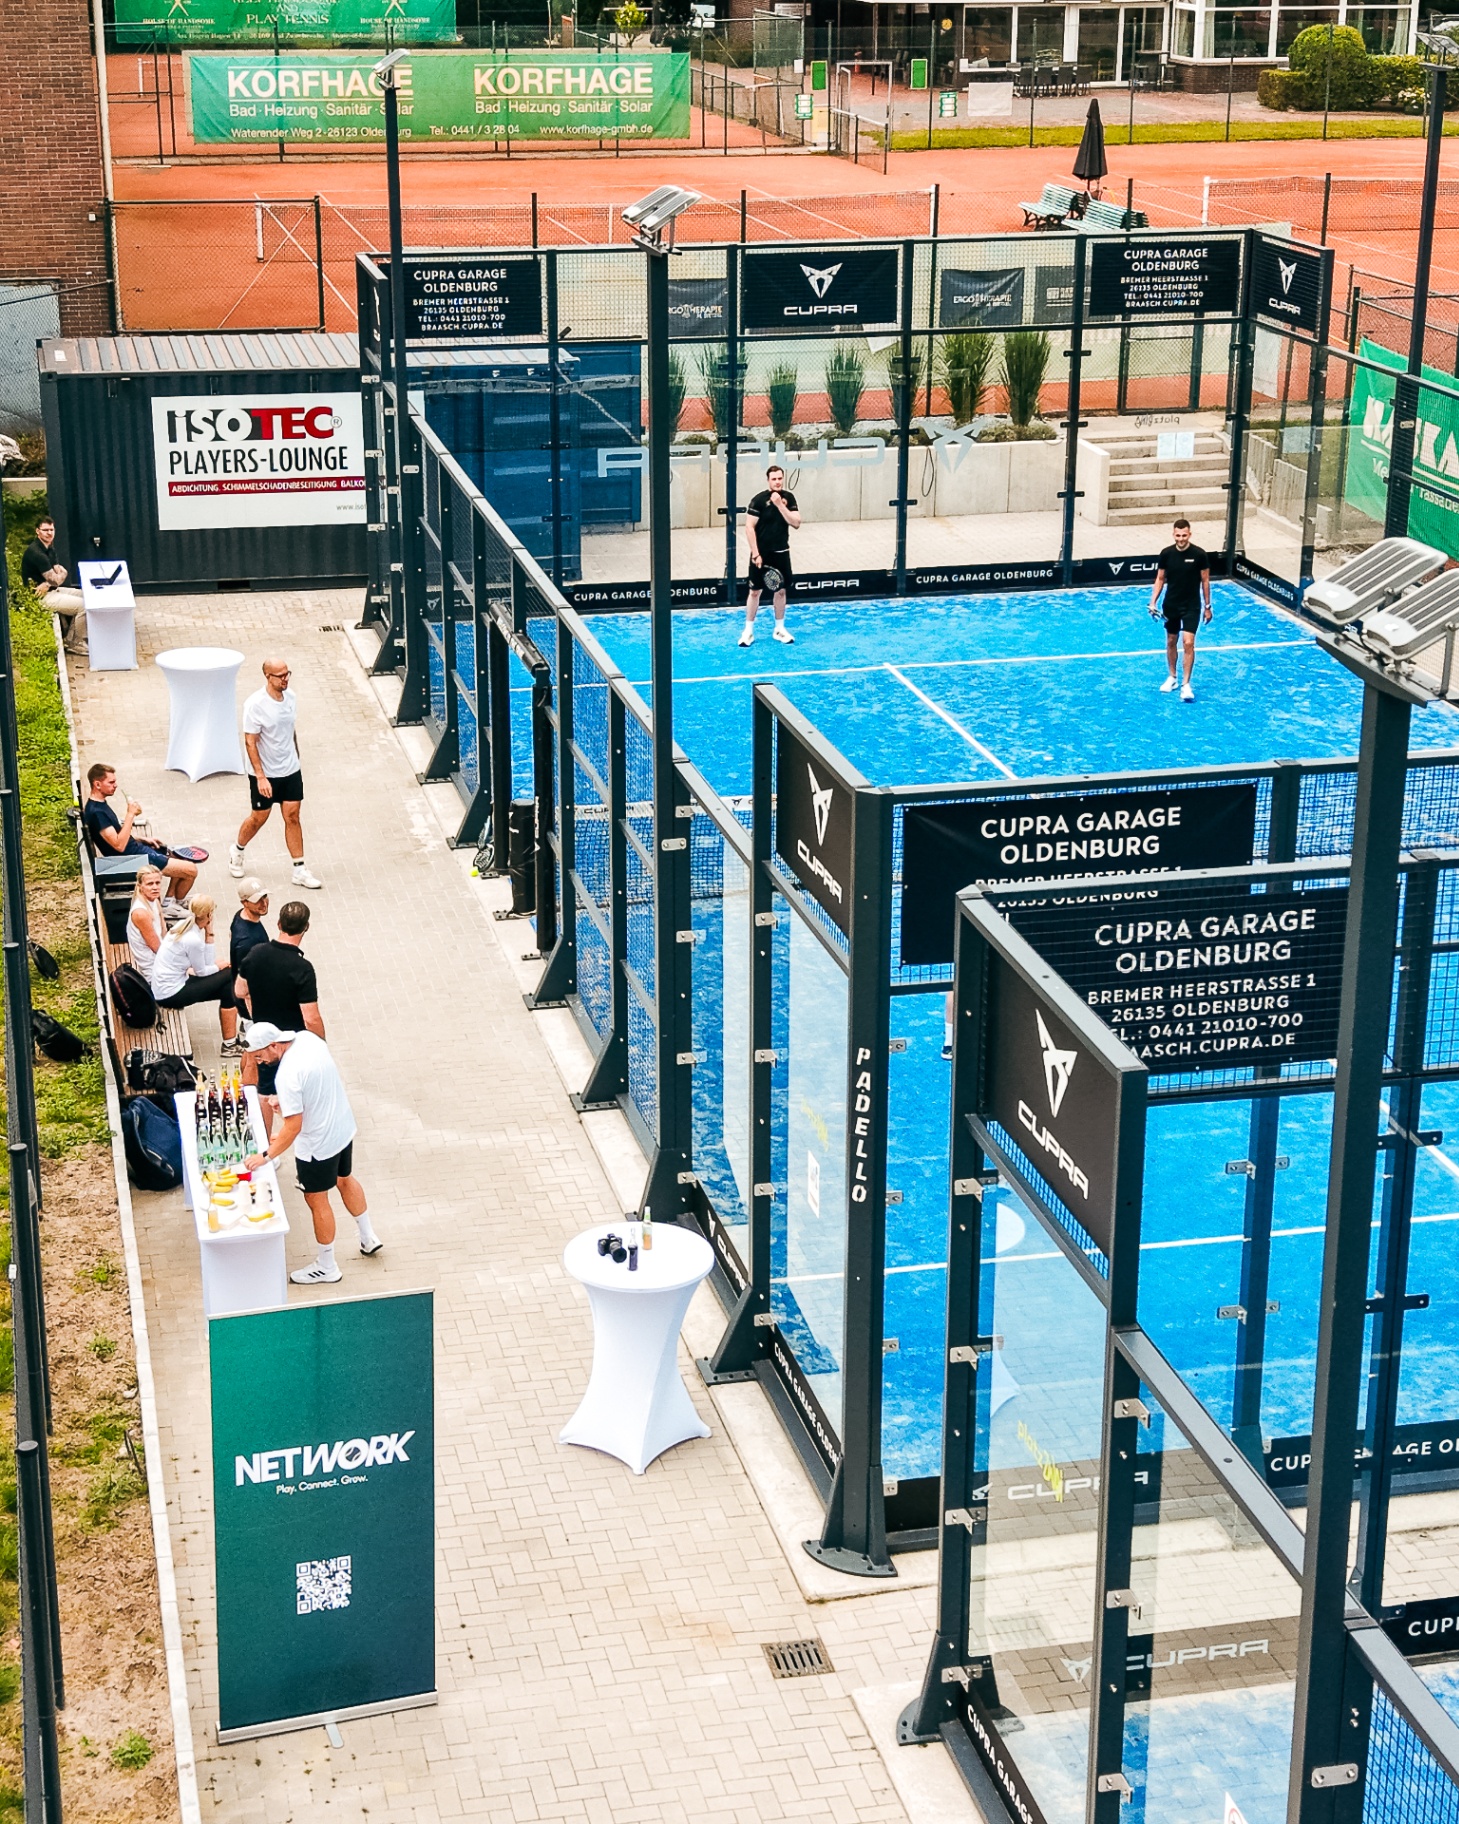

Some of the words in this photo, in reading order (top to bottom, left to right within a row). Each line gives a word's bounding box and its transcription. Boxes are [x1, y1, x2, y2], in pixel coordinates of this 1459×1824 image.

[246, 14, 279, 24] PLAY
[284, 14, 329, 24] TENNIS
[474, 67, 654, 95] KORFHAGE
[230, 104, 256, 117] Bad
[264, 103, 318, 120] Heizung
[326, 102, 372, 116] Sanitär
[380, 102, 414, 116] Slar
[476, 101, 500, 114] Bad
[508, 101, 560, 116] Heizung
[568, 100, 612, 113] Sanitär
[620, 100, 653, 113] Solar
[231, 128, 288, 138] Waterender
[290, 127, 313, 139] Weg
[360, 126, 412, 138] Oldeurg
[451, 125, 474, 135] 0441
[540, 124, 654, 136] www.korfhage-gmbh.de
[1124, 250, 1161, 260] CUPRA
[1164, 248, 1208, 258] GARAGE
[1132, 260, 1200, 272] OLDENBURG
[414, 270, 455, 280] CUPRA
[458, 268, 507, 280] GARAGE
[424, 282, 498, 293] OLDENBURG
[449, 306, 499, 314] OLDENBURG
[784, 304, 858, 316] CUPRA
[1268, 297, 1300, 316] CUPRA
[170, 446, 348, 476] PLAYERS-LOUNGE
[795, 578, 860, 590] CUPRA
[916, 574, 949, 584] CUPRA
[952, 572, 991, 582] GARAGE
[994, 569, 1053, 580] OLDENBURG
[574, 592, 608, 602] CUPRA
[611, 590, 652, 600] GARAGE
[671, 586, 717, 597] DENBURG
[981, 814, 1070, 838] CUPRA
[1076, 806, 1182, 832] GARAGE
[1000, 836, 1160, 864] OLDENBURG
[797, 840, 843, 904] CUPRA
[1095, 919, 1192, 946] CUPRA
[1200, 908, 1316, 938] GARAGE
[1115, 940, 1292, 974] OLDENBURG
[1088, 986, 1164, 1006] BREMER
[1170, 974, 1301, 999] HEERSTRASSE
[1306, 974, 1316, 987] 1
[1111, 1006, 1166, 1023] 26135
[1172, 994, 1290, 1018] OLDENBURG
[1111, 1028, 1143, 1042] EL.:
[1149, 1022, 1195, 1038] 0441
[1201, 1012, 1304, 1035] 21010-700
[1130, 1033, 1296, 1060] AASCH.CUPRA.DE
[852, 1047, 871, 1203] PADELLO
[1017, 1099, 1089, 1200] CUPRA
[774, 1342, 793, 1386] CUPRA
[793, 1378, 817, 1428] GARAGE
[235, 1430, 416, 1486] NETWORK
[1270, 1454, 1312, 1472] CUP
[276, 1484, 296, 1495] Play.
[298, 1478, 340, 1492] Connect.
[341, 1474, 368, 1485] Grow.
[968, 1704, 996, 1766] CUPRA
